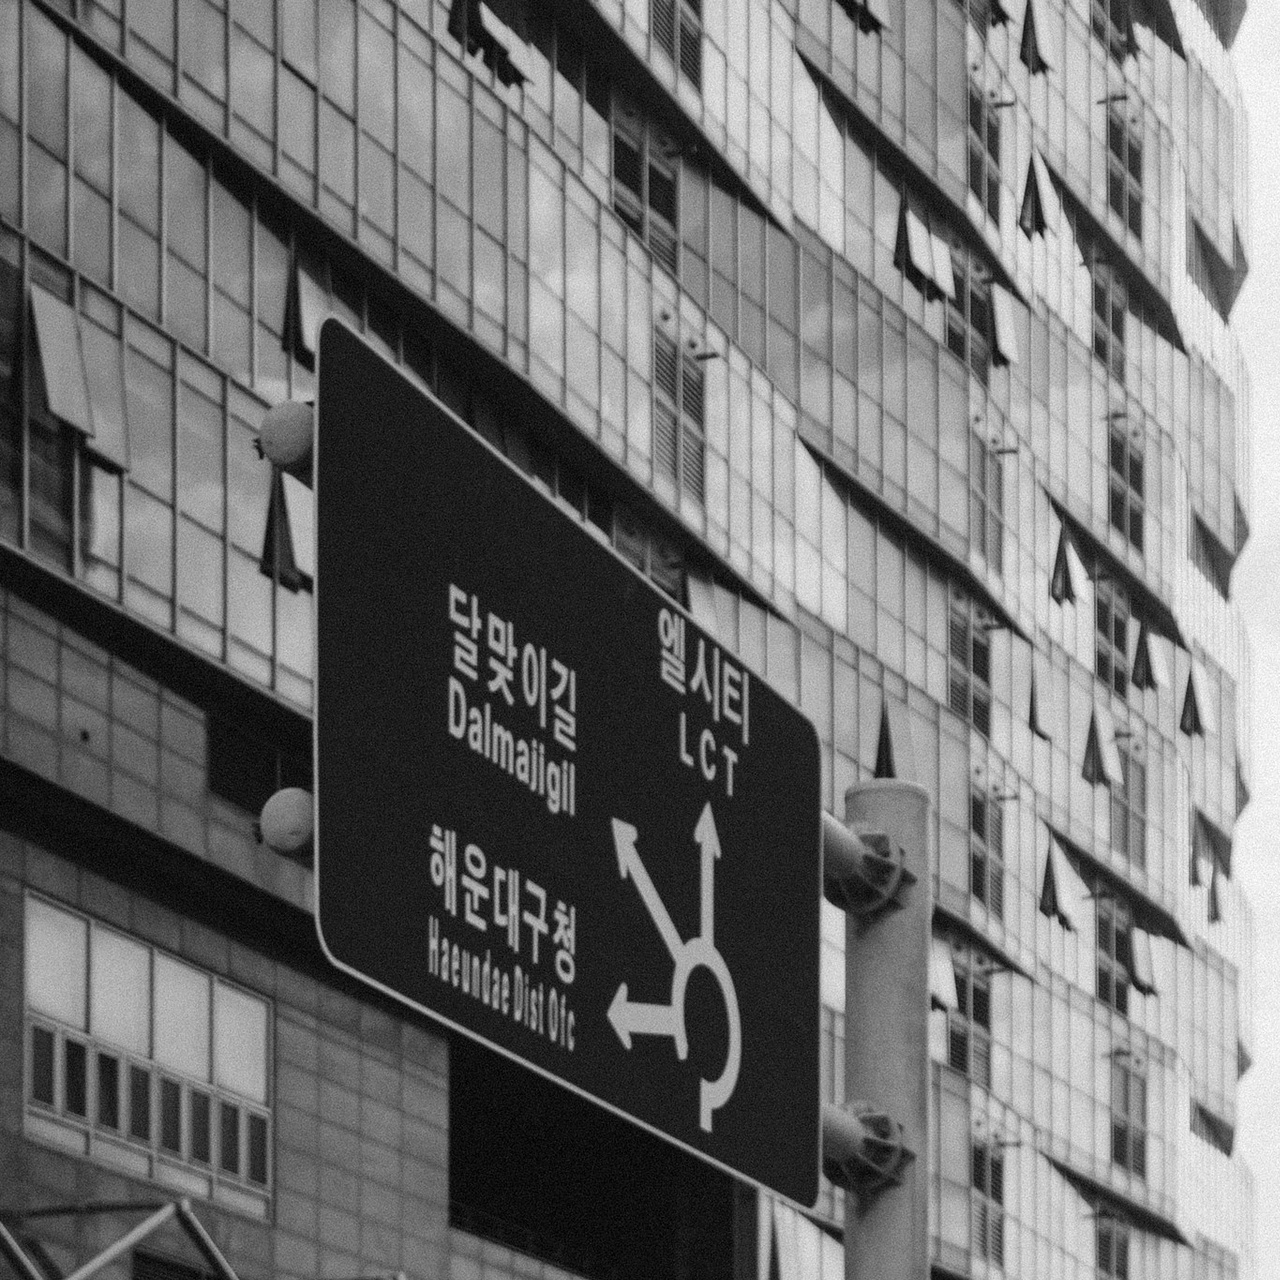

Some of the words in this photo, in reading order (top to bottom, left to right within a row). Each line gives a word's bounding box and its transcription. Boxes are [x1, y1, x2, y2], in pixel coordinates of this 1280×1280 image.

[449, 583, 577, 752] 달맞이길
[657, 607, 750, 747] 엘시티
[449, 676, 576, 817] Dalmajigil
[679, 711, 739, 797] LCT
[429, 823, 576, 984] 해운대구청
[428, 914, 509, 1015] Haeundae
[513, 964, 544, 1035] Dist
[548, 986, 575, 1052] Ofc
